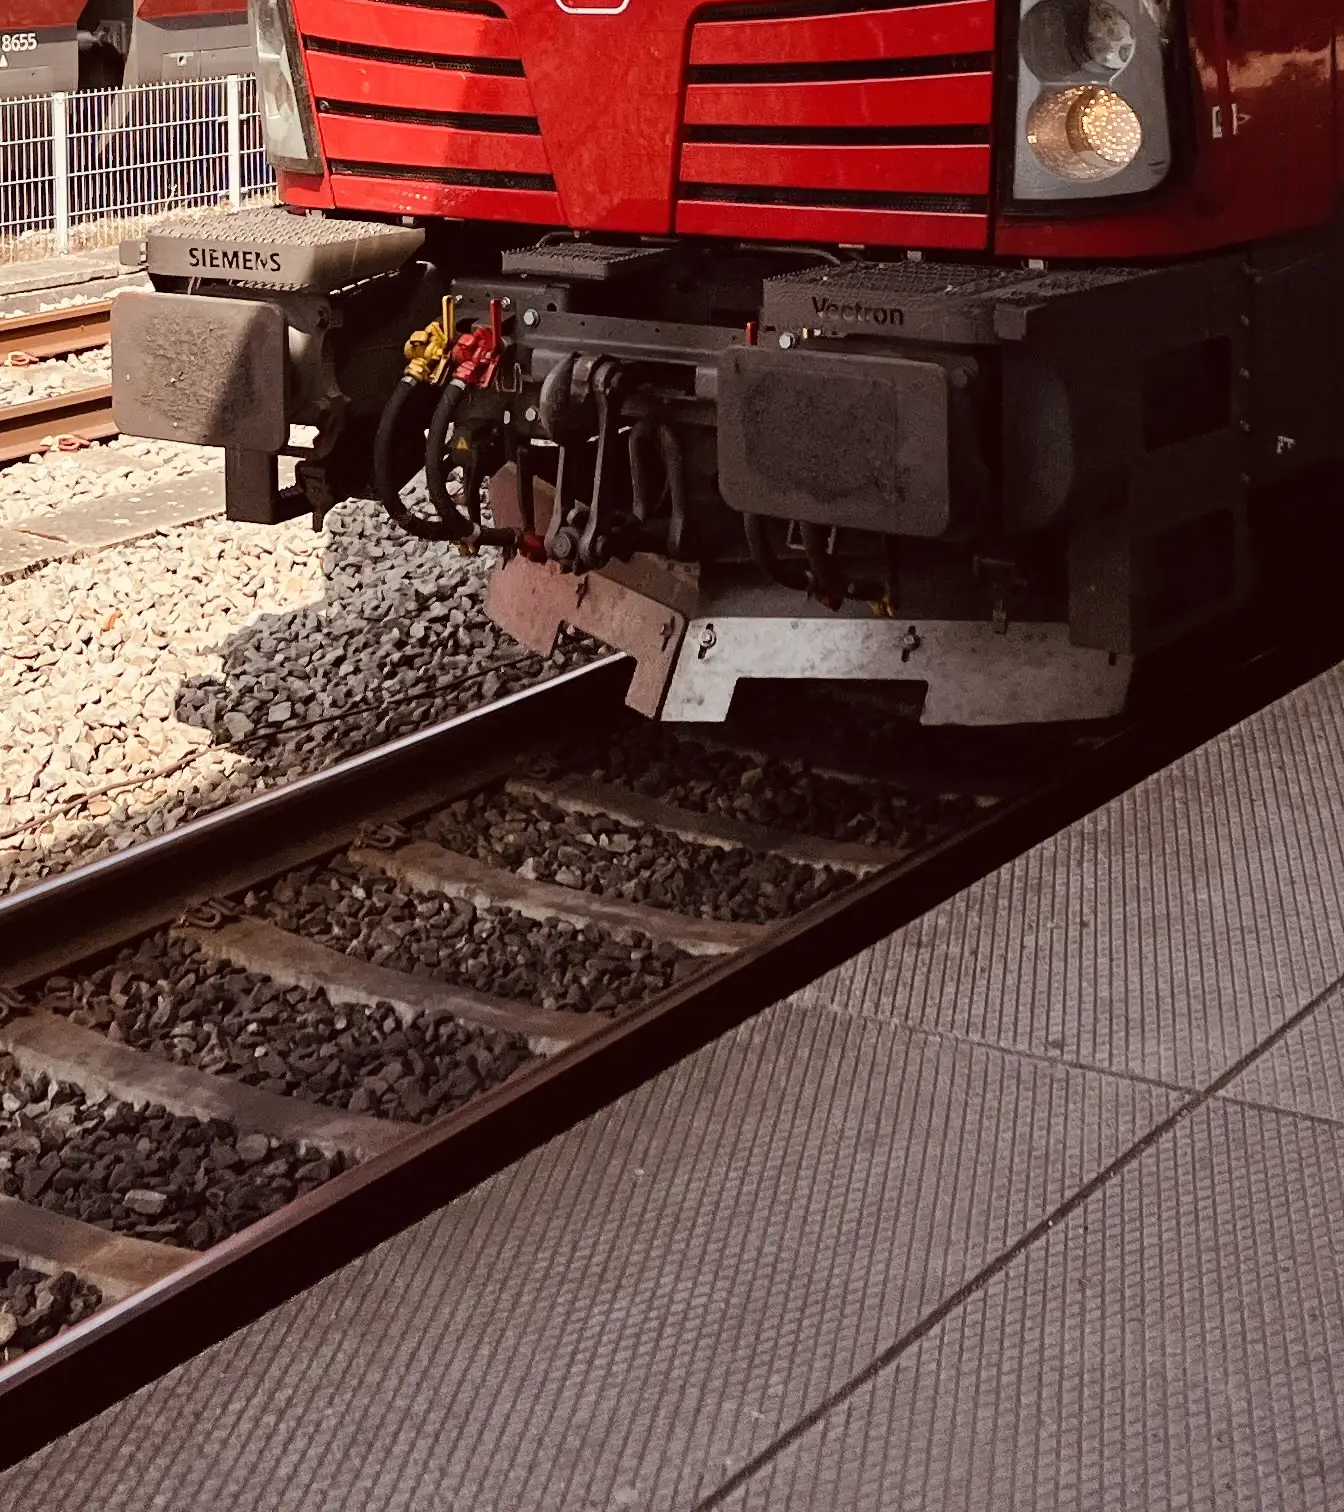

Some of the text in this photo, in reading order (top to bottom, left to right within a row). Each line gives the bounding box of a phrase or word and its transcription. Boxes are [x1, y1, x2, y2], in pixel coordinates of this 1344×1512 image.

[1, 32, 38, 53] 8655
[188, 247, 281, 272] SIEMENS
[811, 295, 905, 326] Vectron
